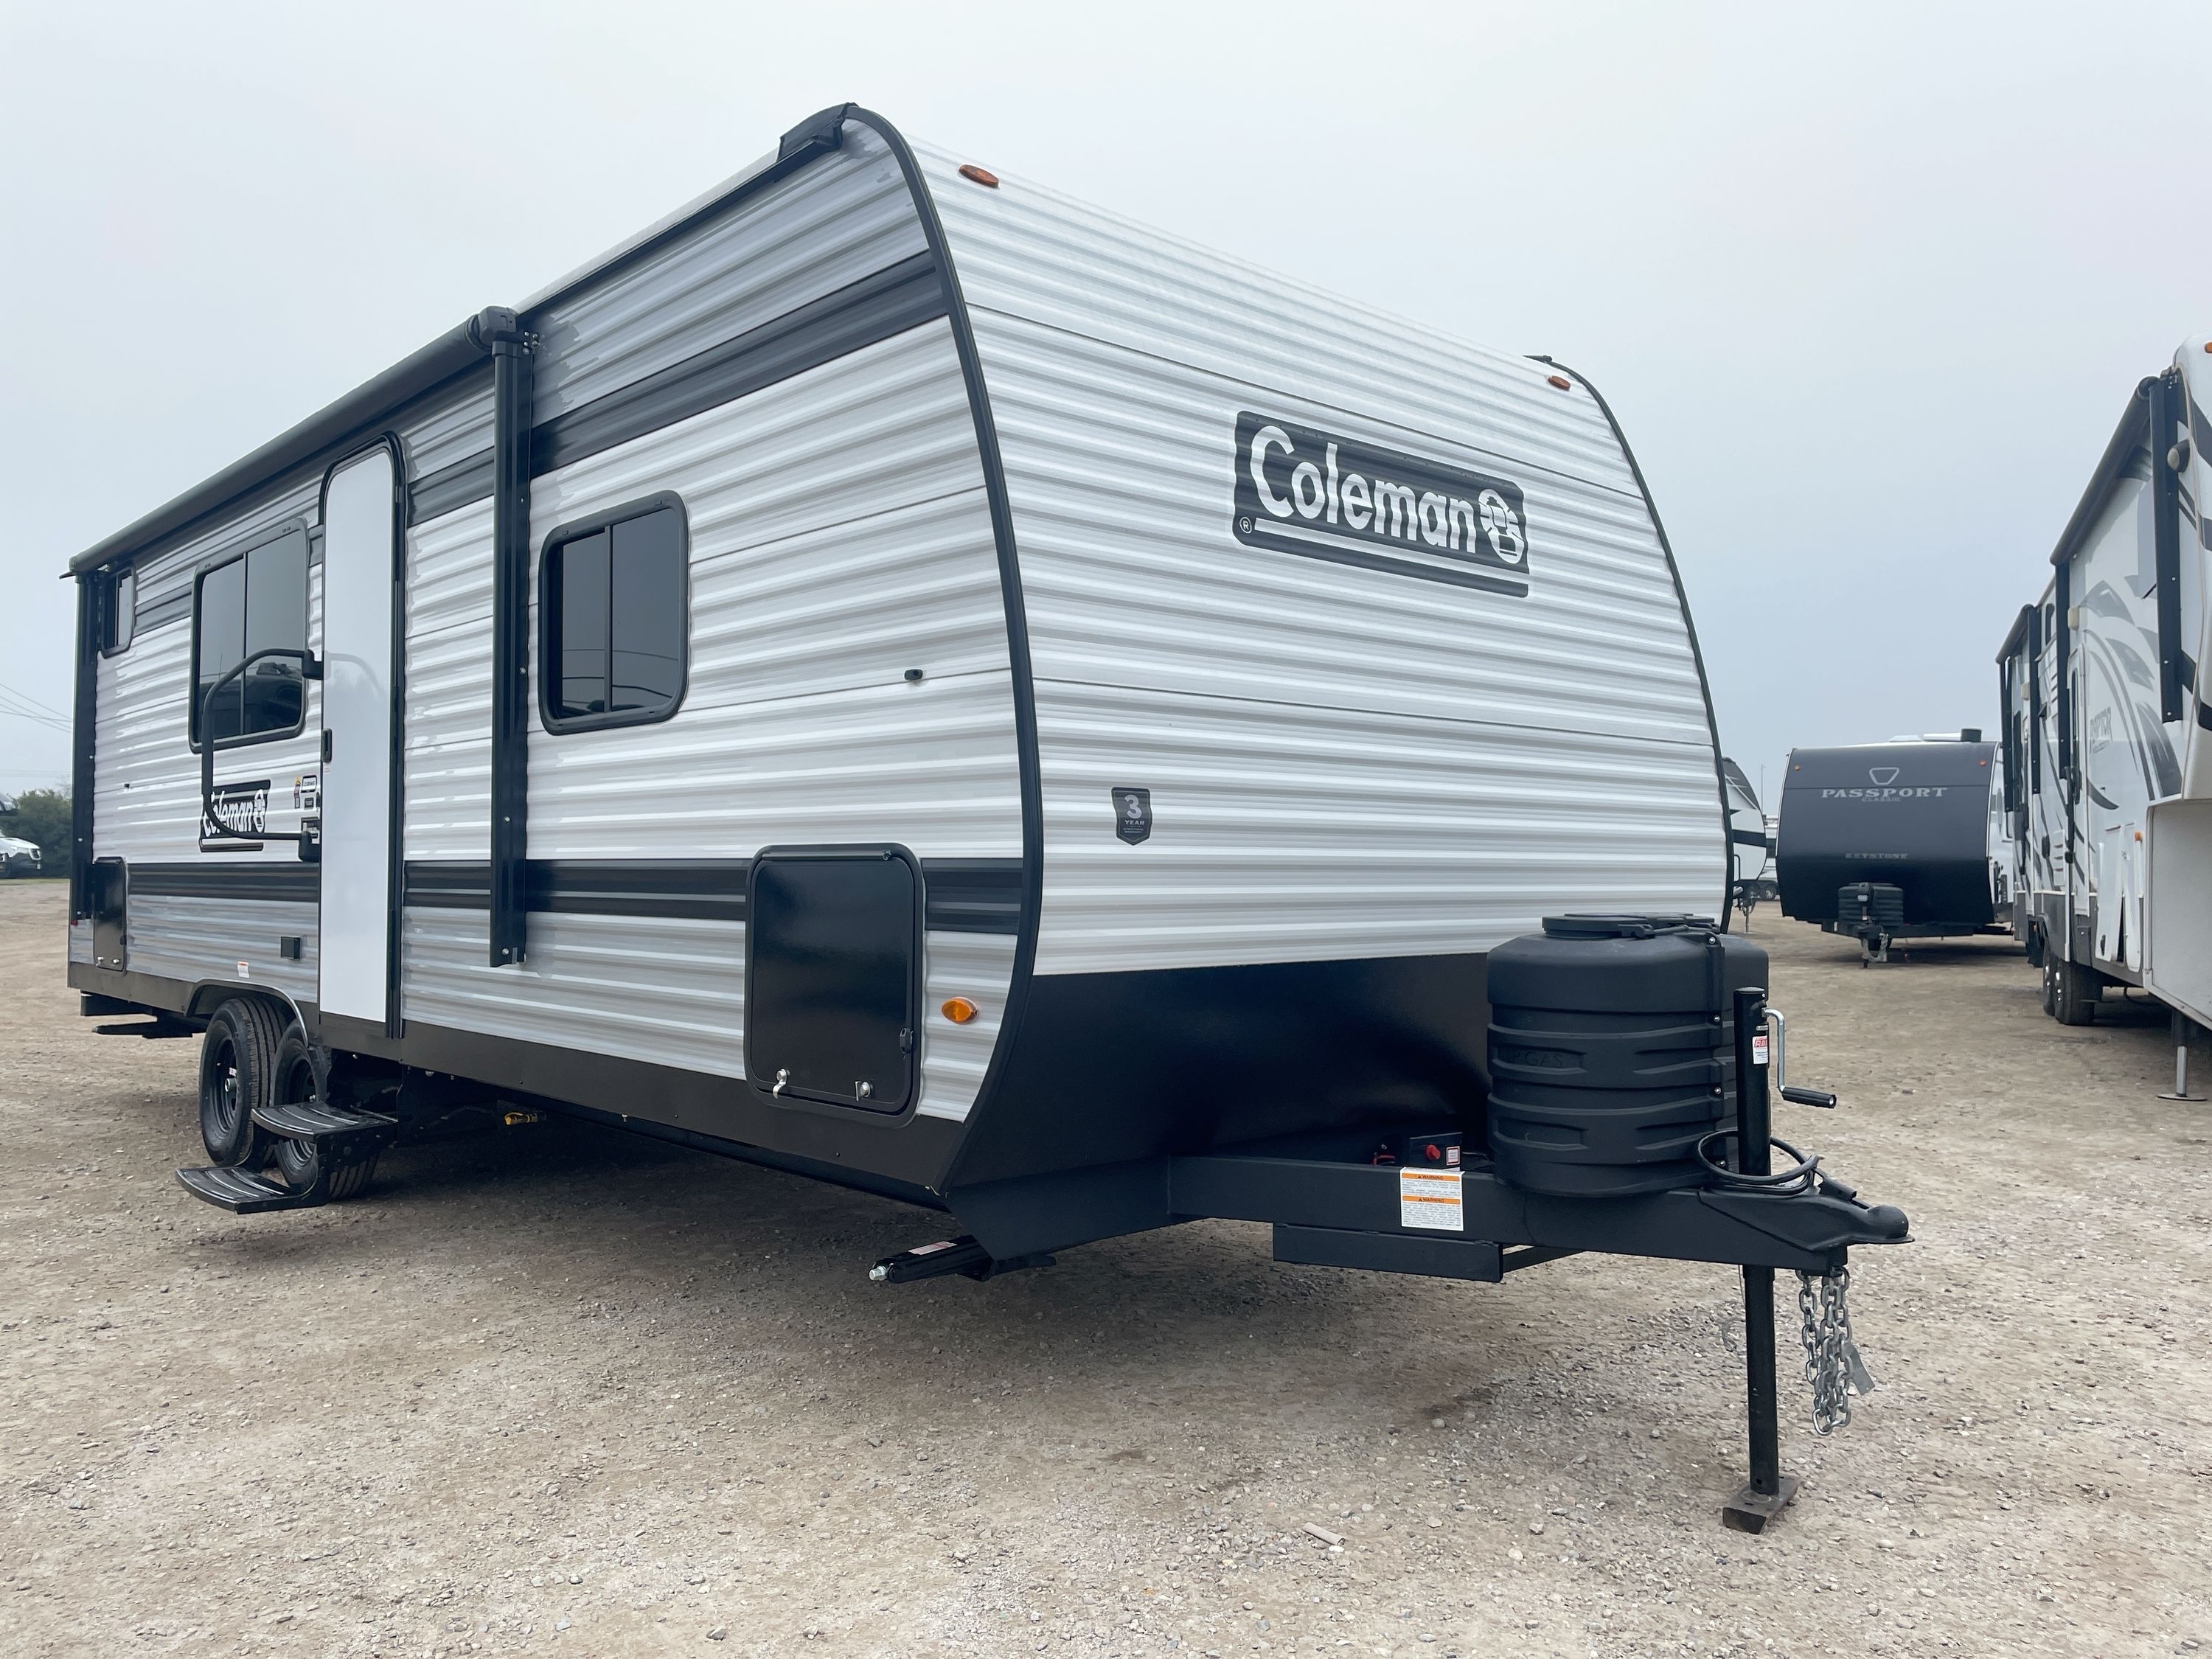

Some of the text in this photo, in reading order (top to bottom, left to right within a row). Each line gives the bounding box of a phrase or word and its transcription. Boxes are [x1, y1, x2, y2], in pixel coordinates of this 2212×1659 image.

[1250, 425, 1477, 554] Coleman
[1821, 787, 1948, 798] PASSPORT
[1124, 794, 1142, 819] 3
